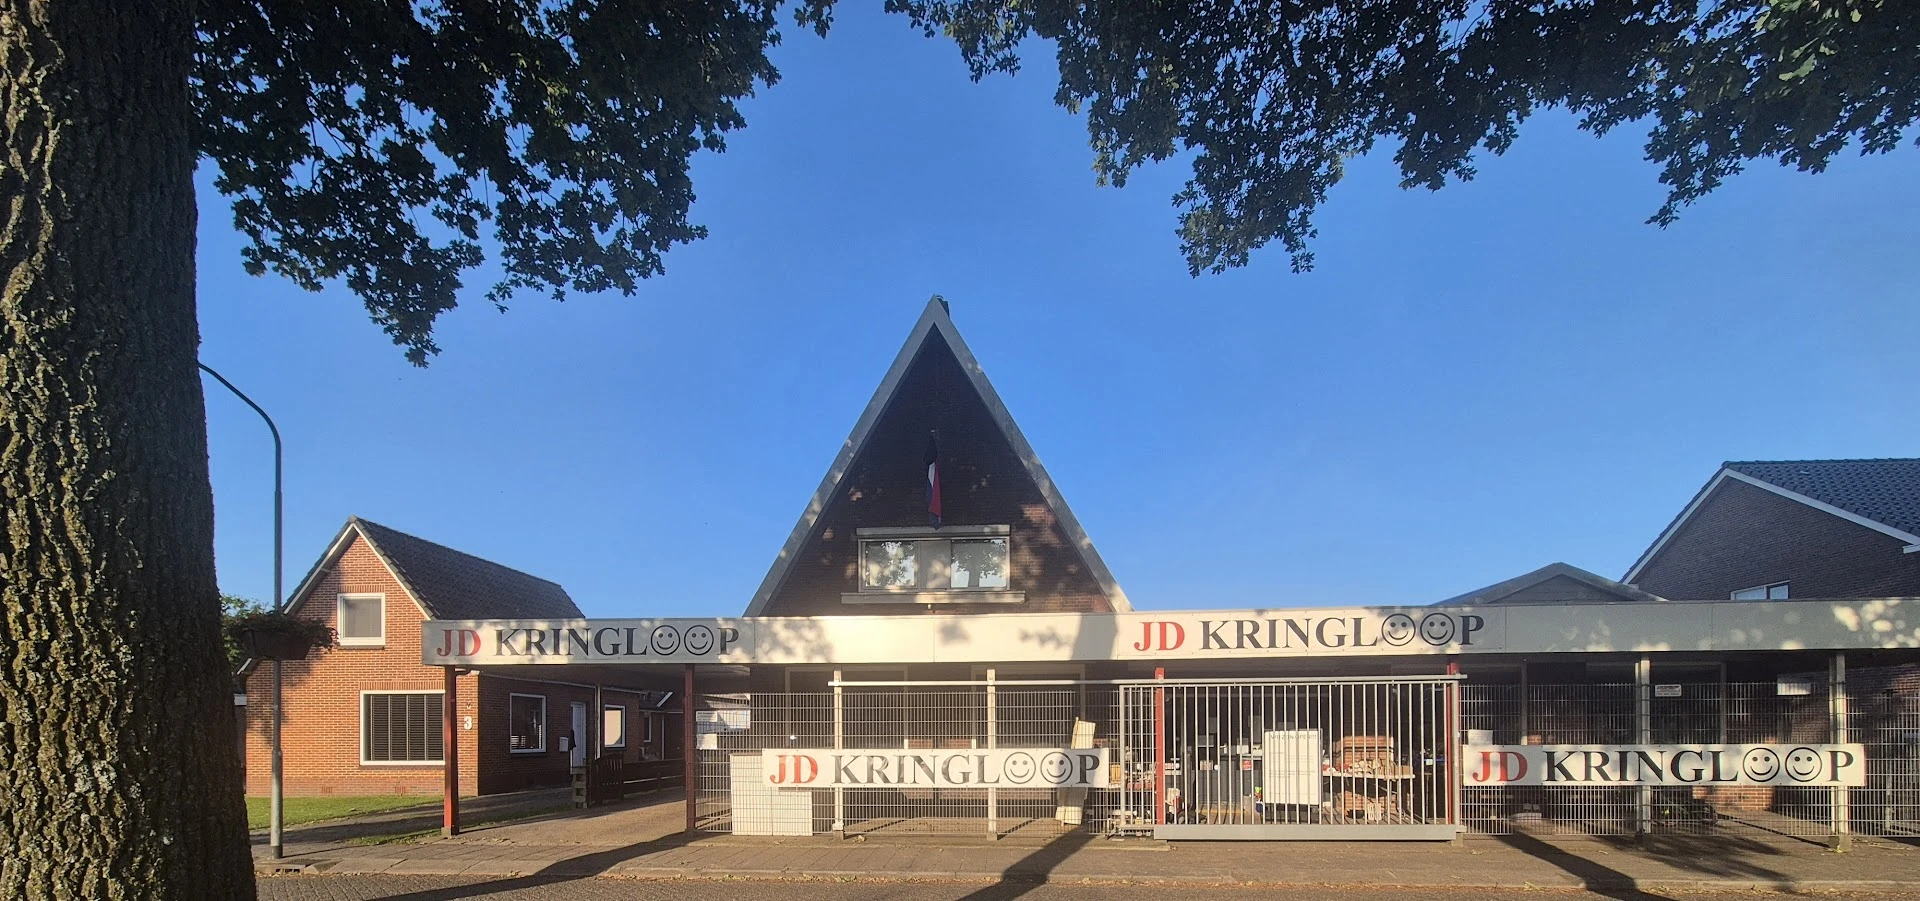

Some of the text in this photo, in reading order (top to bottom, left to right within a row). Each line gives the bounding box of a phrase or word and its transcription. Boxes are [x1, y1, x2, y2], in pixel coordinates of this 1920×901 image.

[436, 628, 481, 657] JD
[1134, 621, 1185, 651] JD
[463, 715, 472, 730] 3
[769, 754, 818, 784] JD
[1472, 750, 1528, 782] JD
